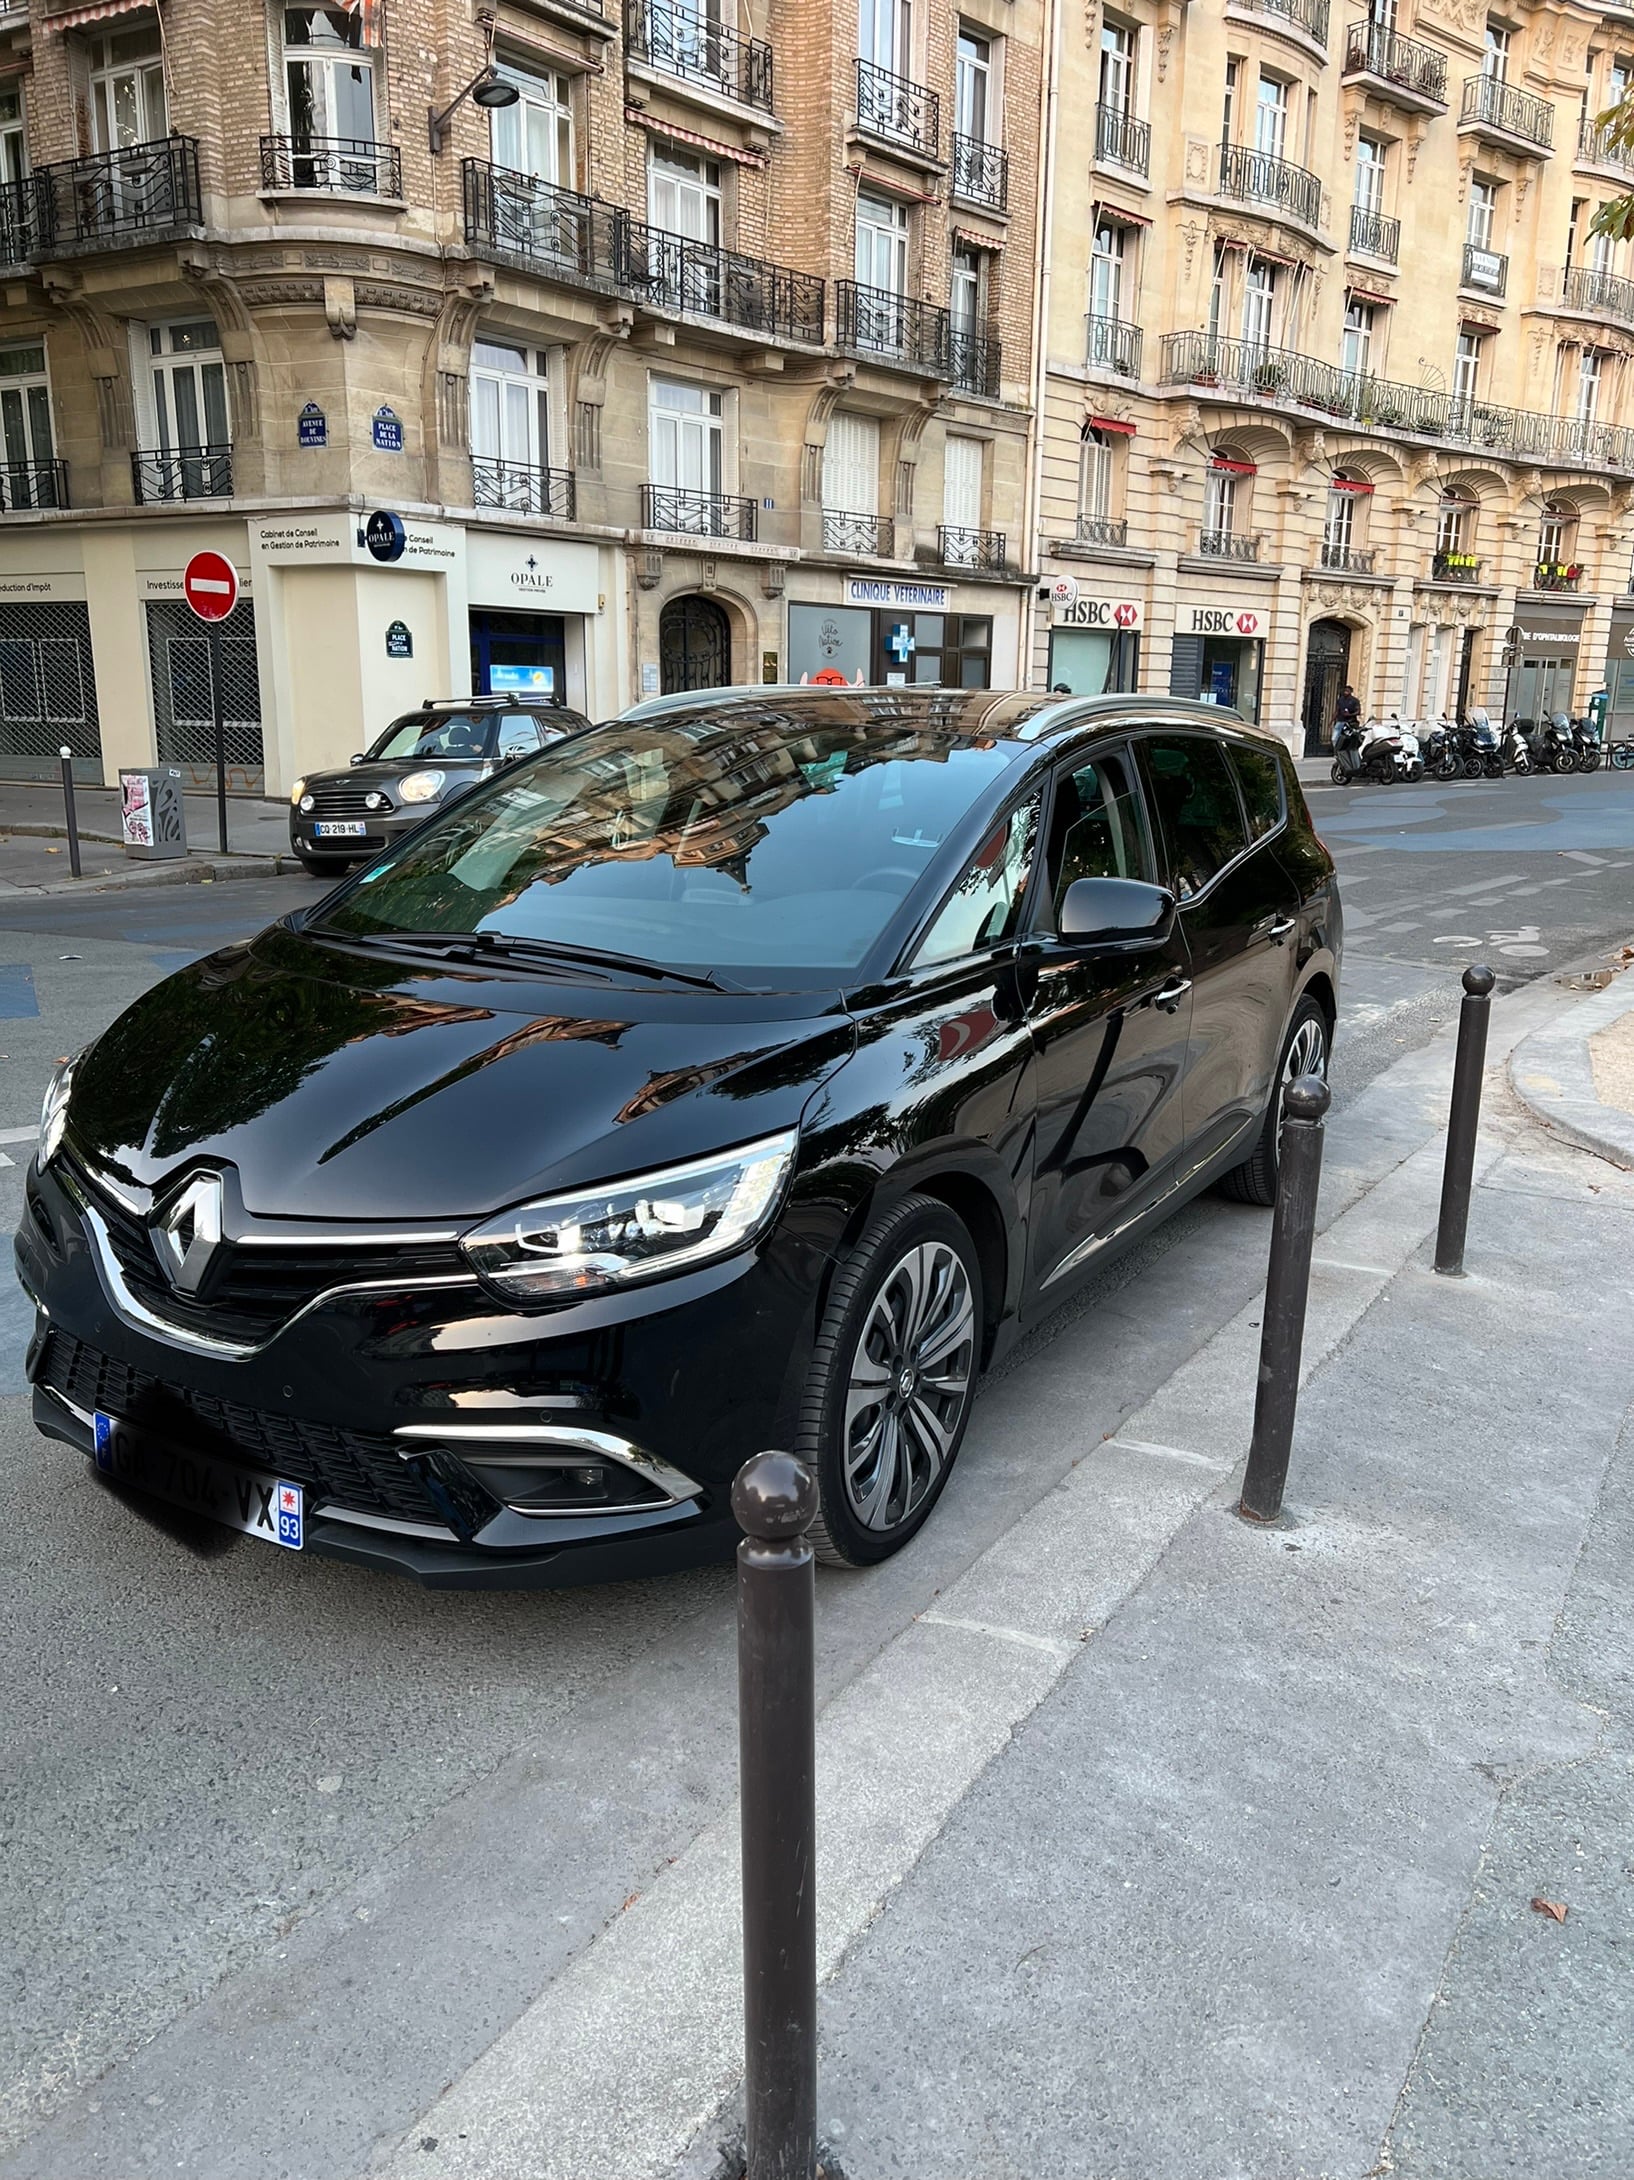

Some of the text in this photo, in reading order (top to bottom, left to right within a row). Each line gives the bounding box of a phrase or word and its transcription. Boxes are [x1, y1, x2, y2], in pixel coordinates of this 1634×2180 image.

[302, 419, 323, 427] AVENUE
[378, 423, 396, 432] PLACE
[379, 430, 396, 440] DE LA
[376, 438, 401, 448] NATION
[260, 528, 318, 538] Cabinet de Conseil
[368, 532, 395, 542] OPALE
[409, 534, 433, 544] Conseil
[270, 541, 294, 550] Gestion
[295, 541, 303, 549] de
[304, 539, 340, 548] Patrimoine
[409, 546, 418, 554] de
[418, 546, 455, 558] Patrimoine
[510, 572, 553, 587] OPALE
[147, 580, 184, 590] Investisse
[851, 582, 945, 605] CLINIQUE VETERINAIRE
[1051, 592, 1073, 602] HSBC
[1063, 601, 1111, 625] HSBC
[1191, 609, 1234, 632] HSBC
[280, 1515, 299, 1539] 93
